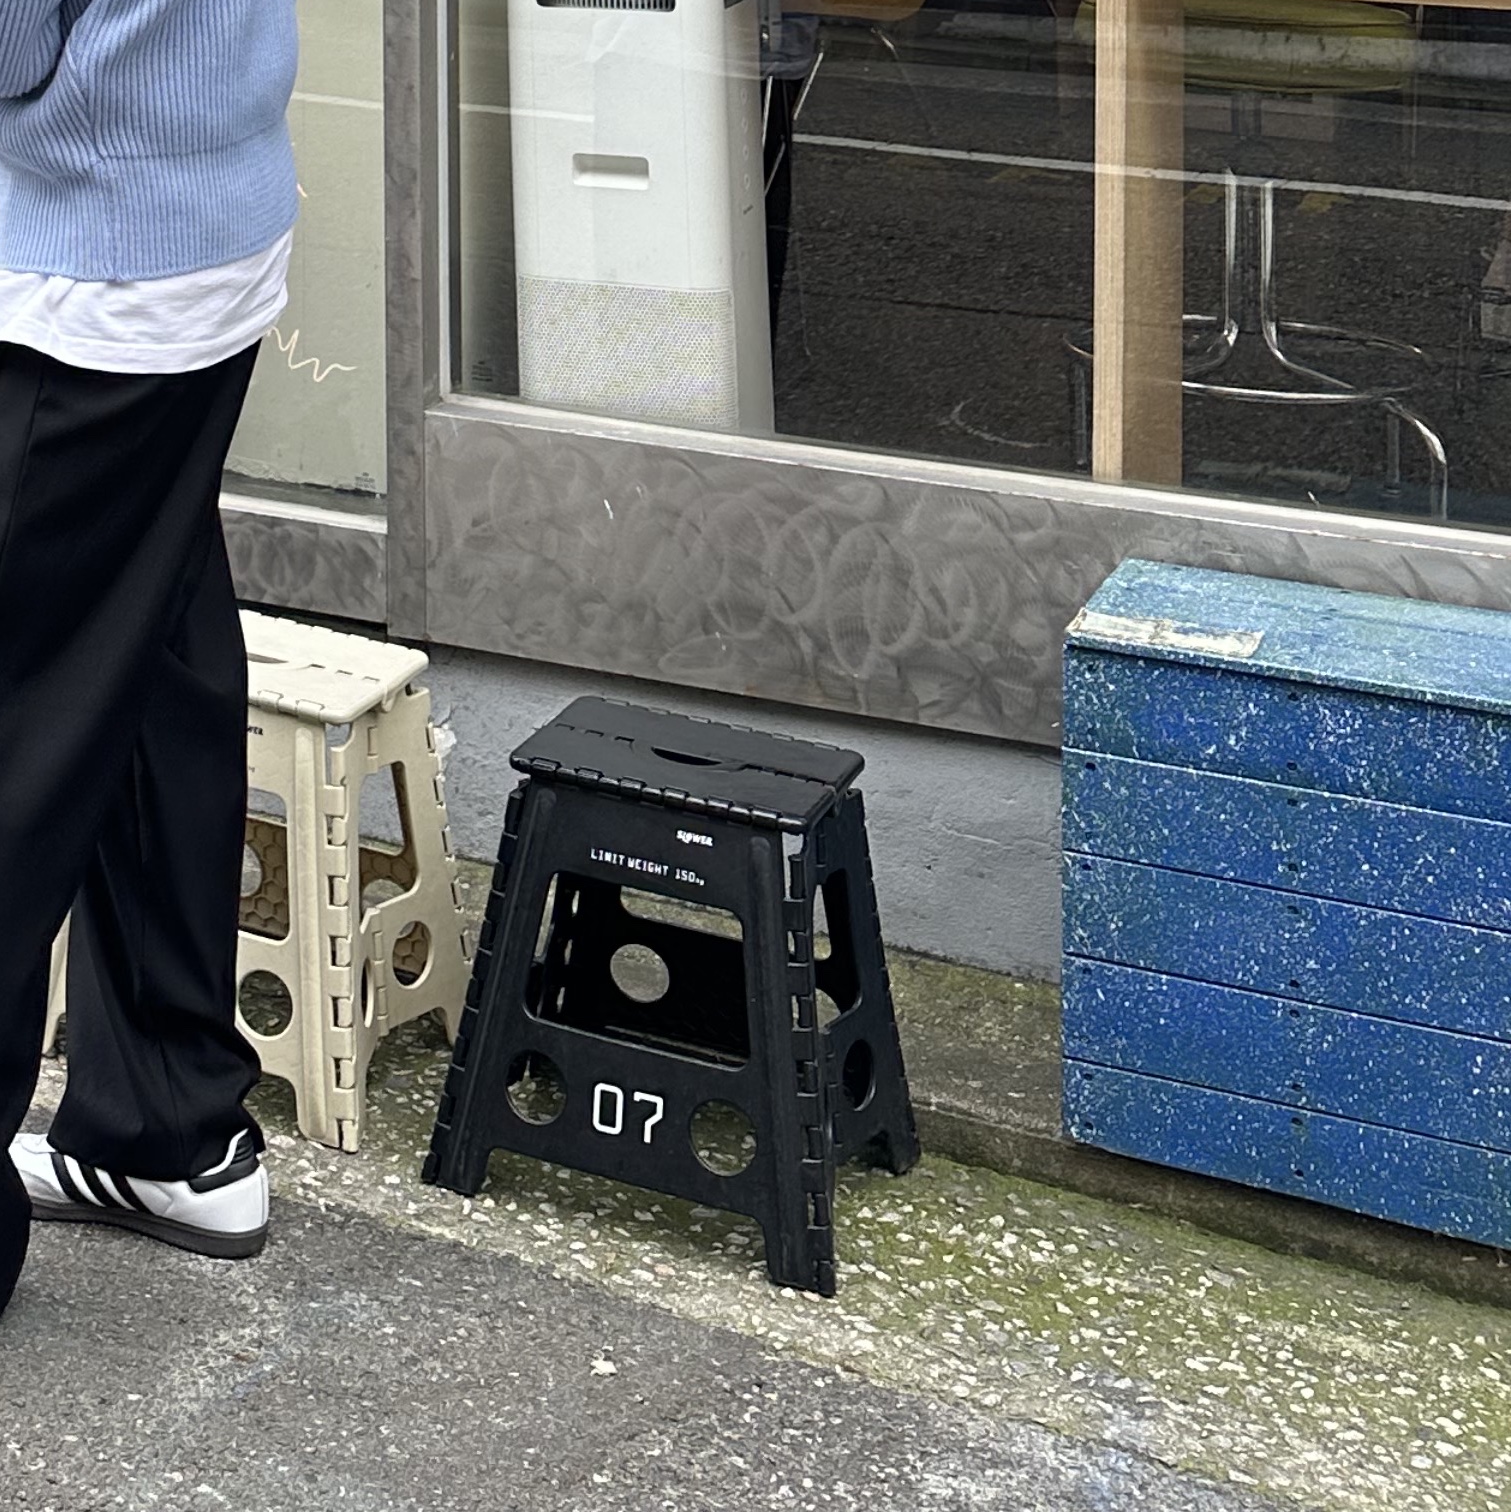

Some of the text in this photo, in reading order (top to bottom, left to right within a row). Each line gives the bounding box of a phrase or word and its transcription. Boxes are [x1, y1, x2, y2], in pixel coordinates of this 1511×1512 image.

[675, 829, 714, 847] SLOWER
[589, 847, 626, 867] LIMIT
[626, 856, 669, 877] WEIGHT
[591, 1081, 666, 1144] 07
